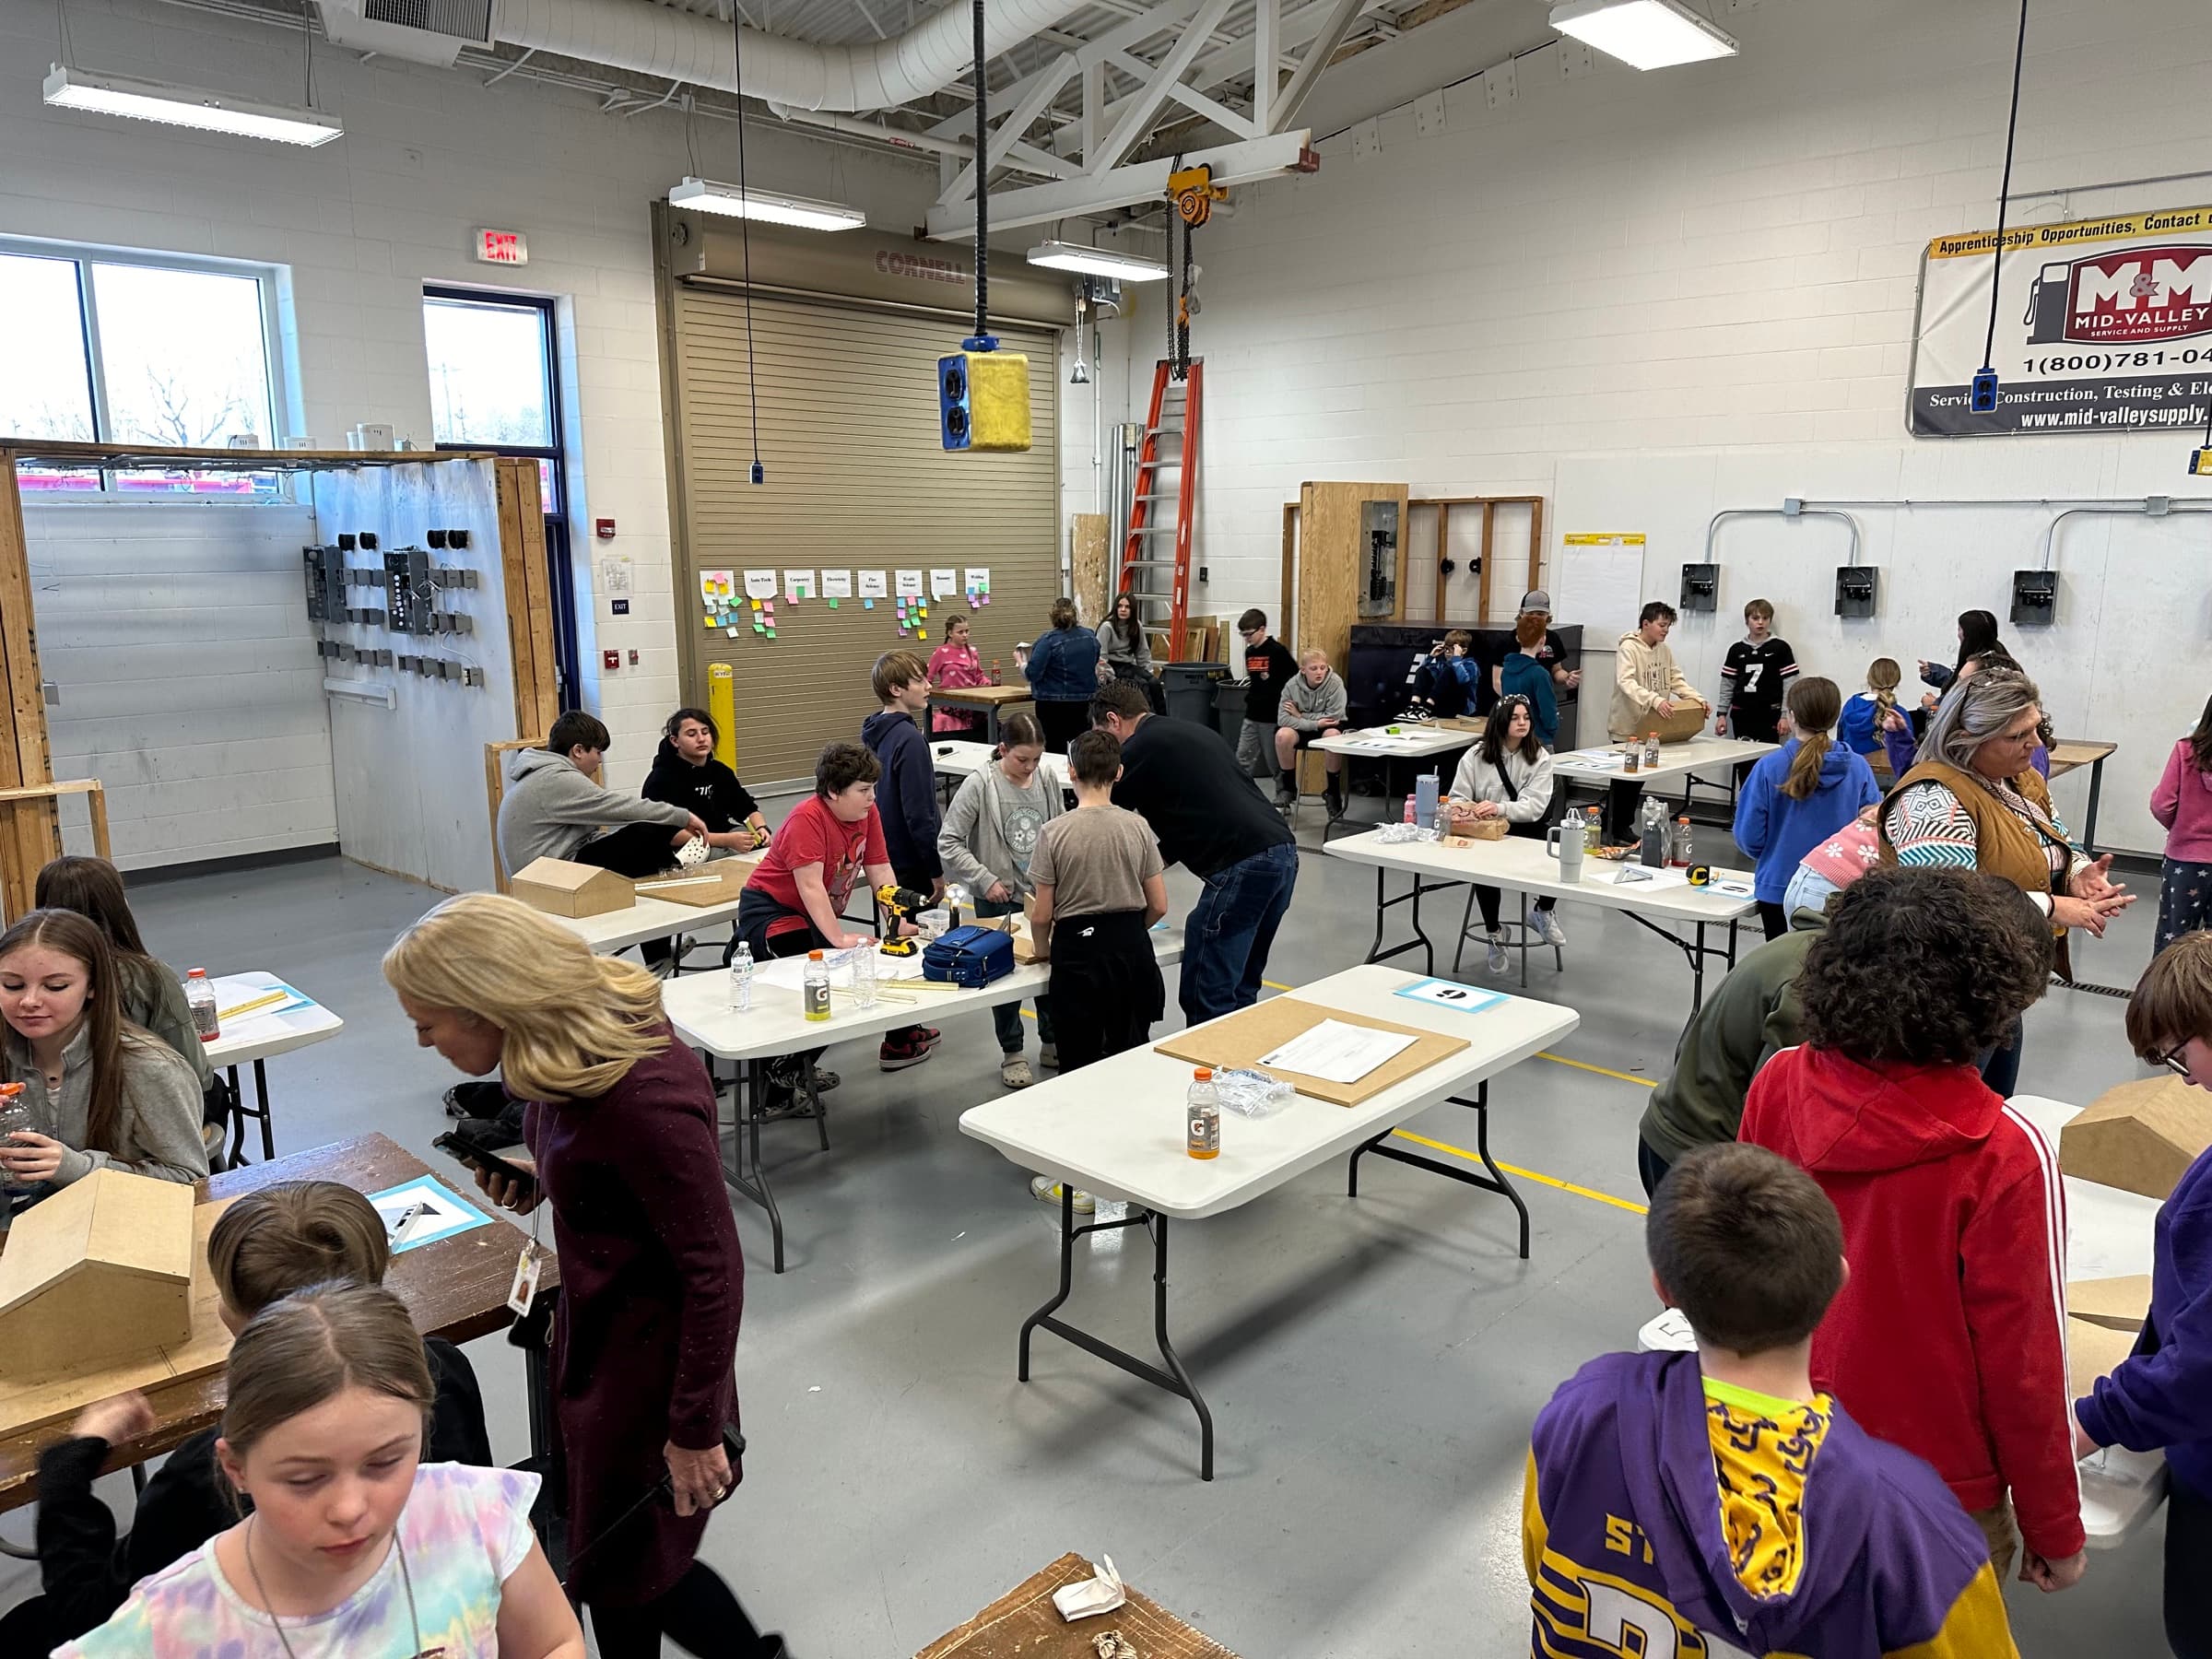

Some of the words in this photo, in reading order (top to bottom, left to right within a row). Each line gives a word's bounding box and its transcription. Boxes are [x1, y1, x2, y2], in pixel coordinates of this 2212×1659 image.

[1939, 231, 2034, 254] Apprenticeship
[2041, 221, 2136, 243] Opportunities,
[2145, 213, 2200, 230] Contact
[486, 231, 517, 261] EXIT
[876, 250, 965, 285] CORNELL
[2075, 307, 2209, 329] MID-VALLEY
[2090, 328, 2128, 337] SERVICE
[2130, 326, 2150, 335] AND
[2154, 324, 2189, 333] SUPPLY
[1930, 393, 1971, 406] Servi
[1996, 387, 2099, 404] Construction,
[2103, 383, 2163, 400] Testing
[2168, 382, 2184, 396] &
[1744, 664, 1763, 692] 7
[816, 987, 828, 1002] G
[1190, 1119, 1205, 1136] G
